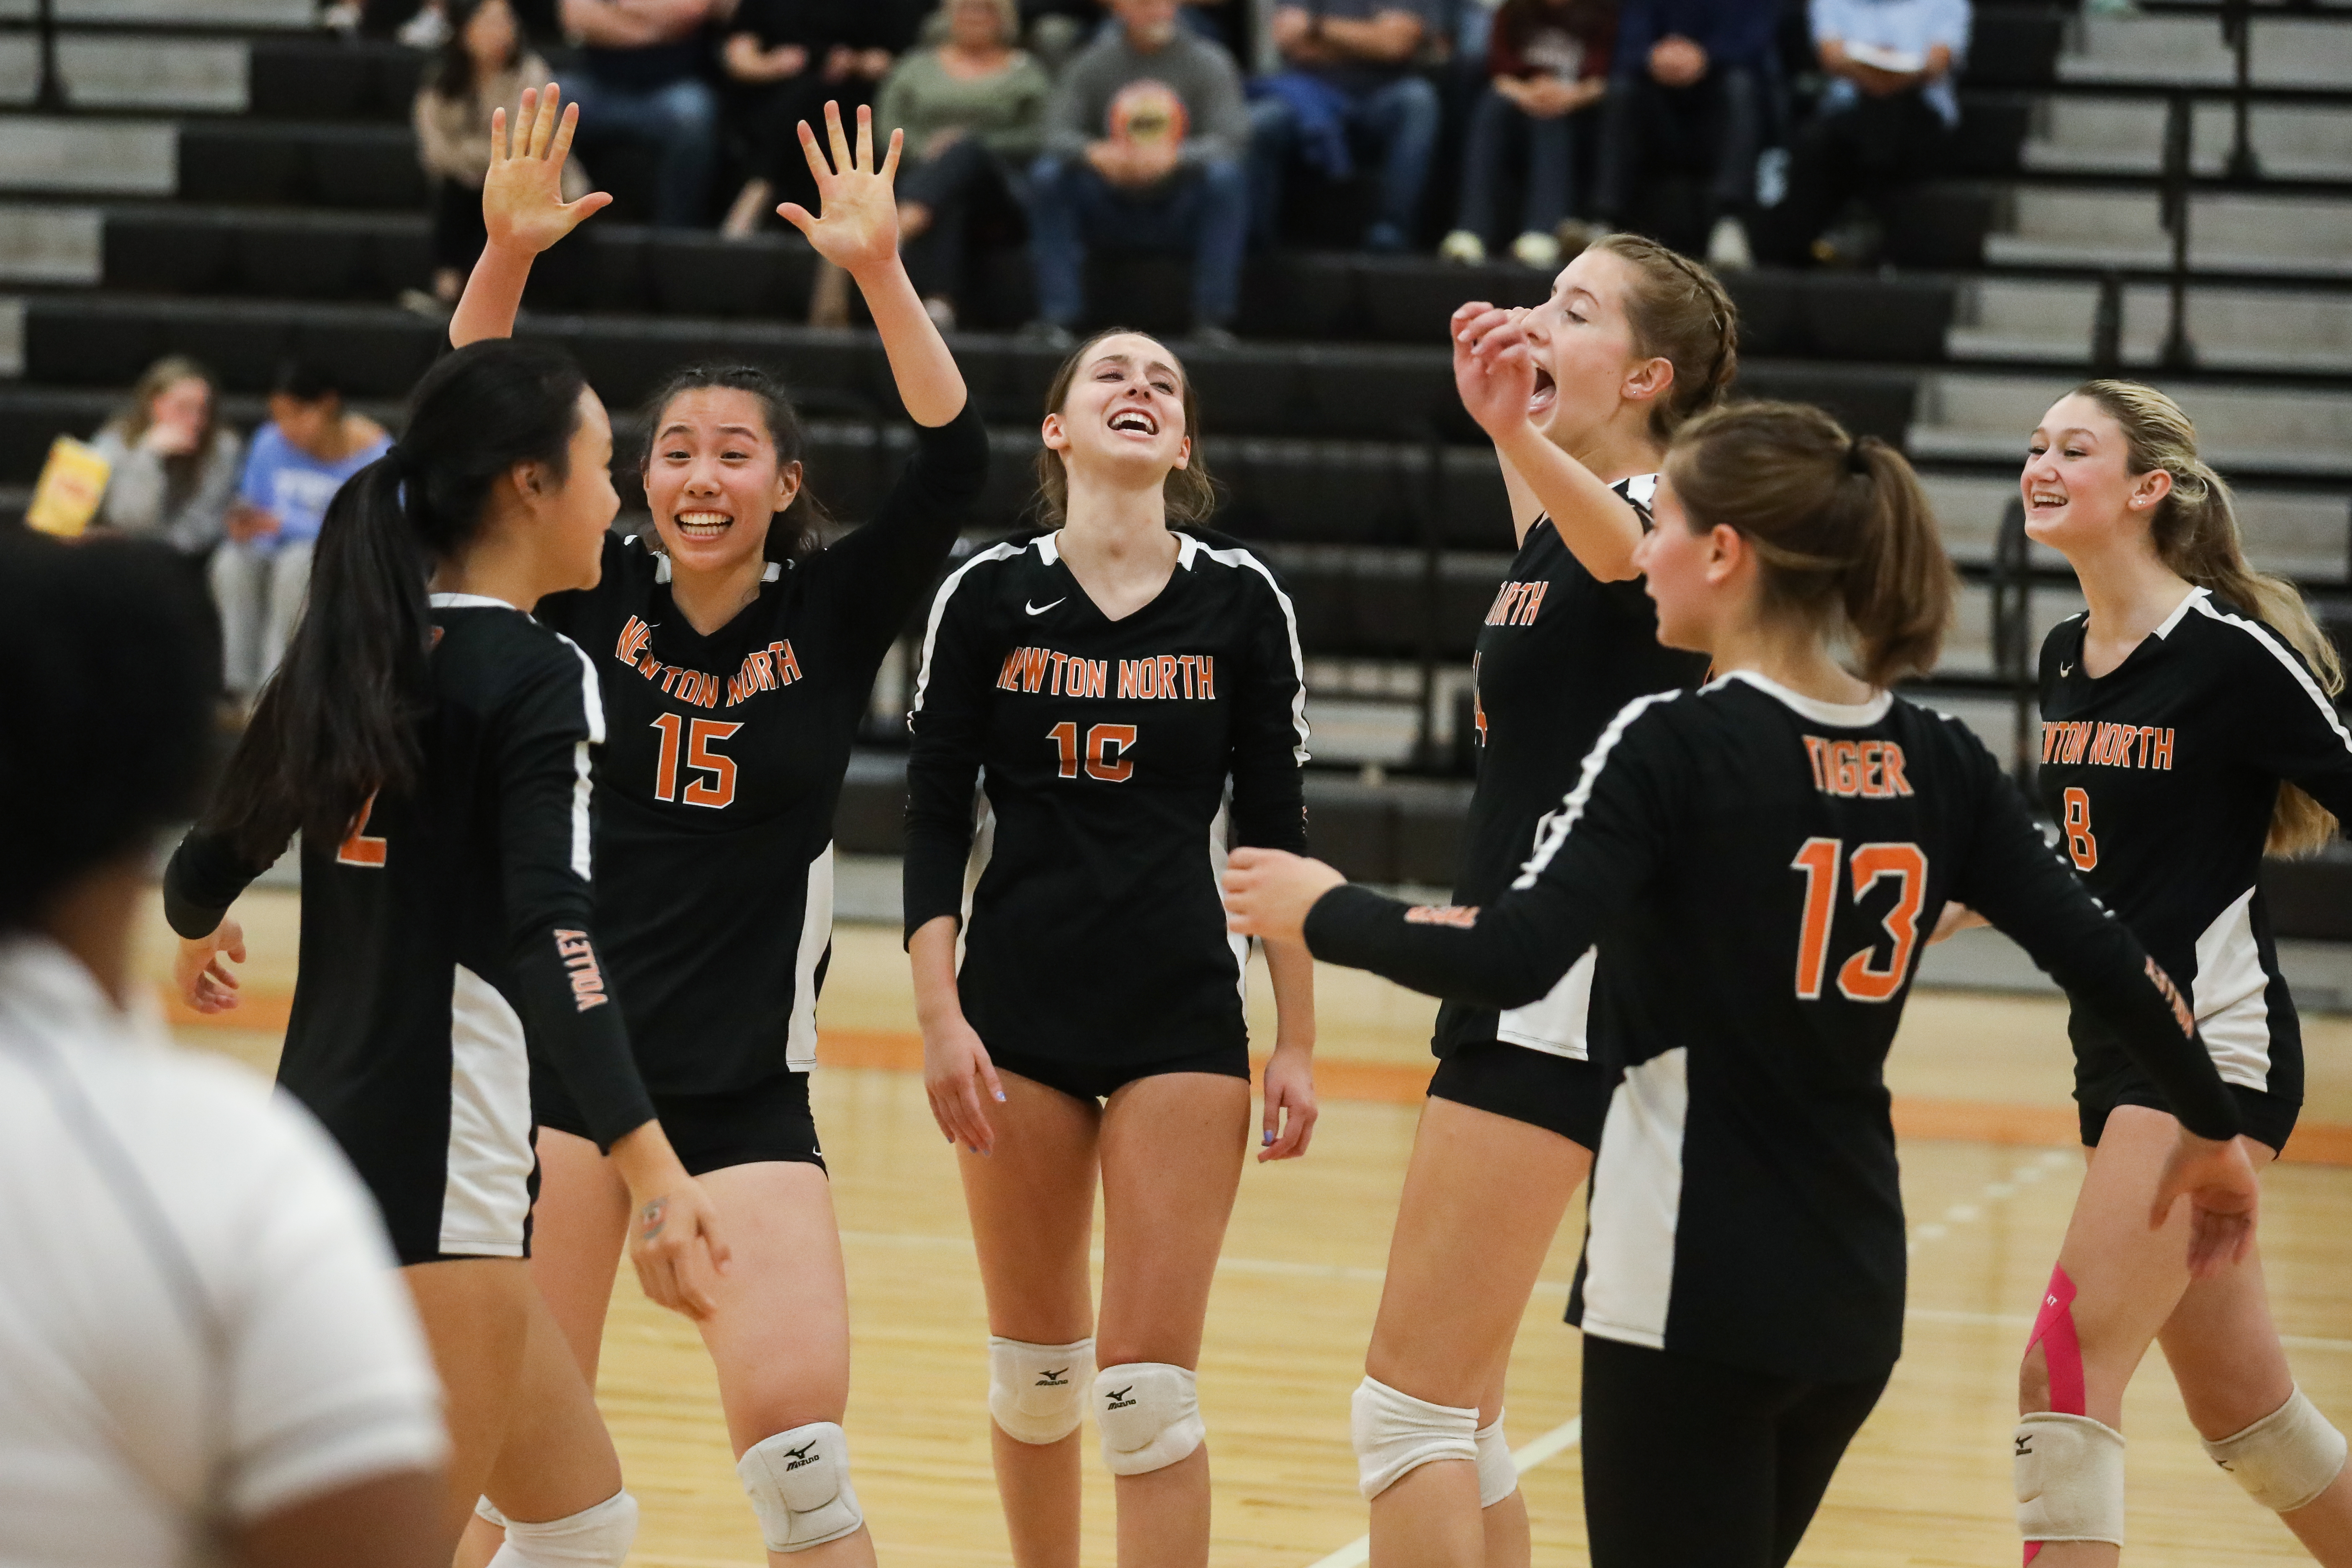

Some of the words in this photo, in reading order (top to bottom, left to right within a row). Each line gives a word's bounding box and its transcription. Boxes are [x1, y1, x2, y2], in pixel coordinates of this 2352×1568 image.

[726, 639, 803, 708] NORTH
[1118, 655, 1216, 700] NORTH
[650, 712, 745, 809] 15
[1801, 734, 1914, 800] TIGER
[2088, 721, 2175, 771] NORTH
[2063, 787, 2097, 873] 8
[1789, 837, 1929, 1002] 13
